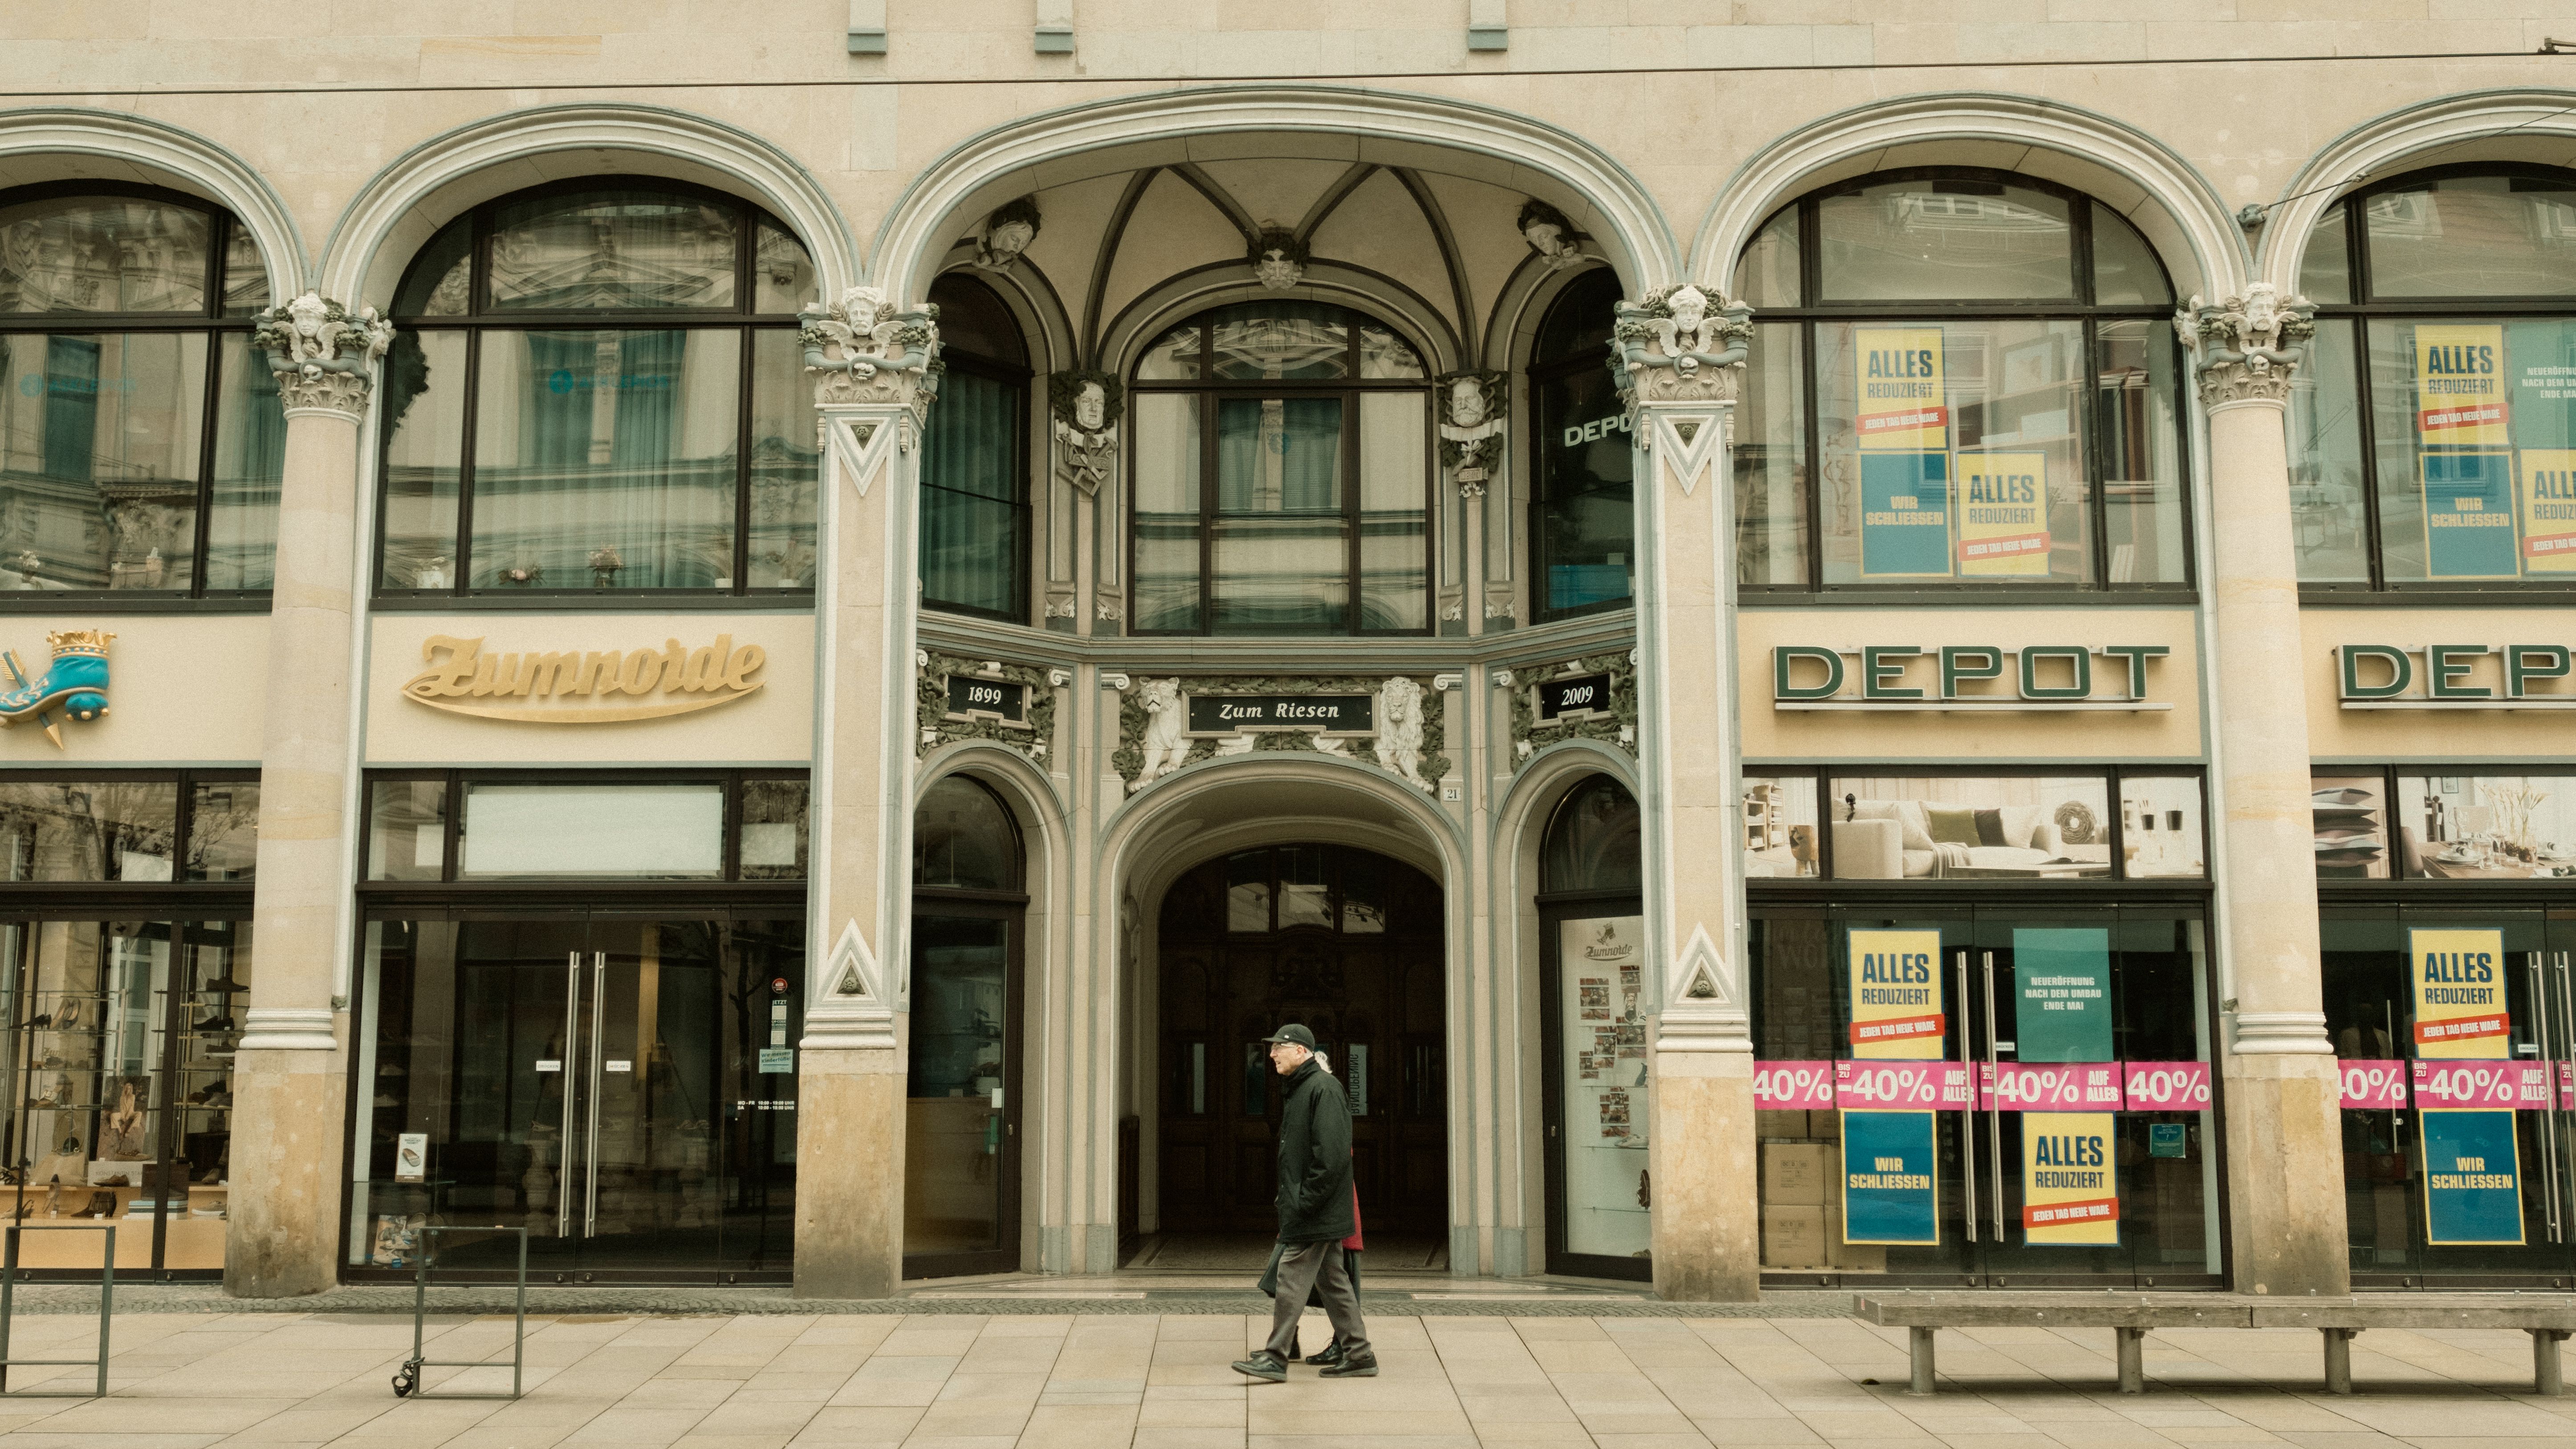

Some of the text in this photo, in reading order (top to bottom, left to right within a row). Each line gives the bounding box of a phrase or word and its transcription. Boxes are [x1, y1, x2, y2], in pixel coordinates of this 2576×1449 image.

[1868, 350, 1933, 377] ALLES
[2428, 345, 2493, 374] ALLES
[1868, 382, 1933, 398] REDUZIERT
[2429, 379, 2495, 394] REDUZIERT
[2522, 379, 2544, 387] NACH
[2547, 379, 2564, 387] DEM
[2540, 390, 2561, 398] ENDE
[1865, 418, 1885, 429] JEDEN
[1886, 417, 1900, 426] TAG
[1918, 412, 1939, 423] WARE
[2427, 409, 2500, 425] JEDEN TAG NEUE WARE
[1970, 475, 2035, 503] ALLES
[1891, 496, 1918, 509] WIR
[2455, 498, 2483, 511] WIR
[1866, 512, 1944, 525] SCHLIESSEN
[1970, 508, 2036, 524] REDUZIERT
[2431, 513, 2510, 527] SCHLIESSEN
[2554, 538, 2568, 549] TAG
[402, 633, 767, 700] Zumnorde
[1774, 645, 2170, 701] DEPOT
[2336, 644, 2572, 699] DEP
[968, 686, 1001, 704] 1899
[1561, 686, 1593, 706] 2009
[1219, 702, 1339, 719] Zum Riesen
[1447, 789, 1457, 799] 21
[1584, 944, 1632, 957] Zumnorde
[1862, 953, 1929, 983] ALLES
[2425, 953, 2492, 983] ALLES
[2031, 975, 2095, 986] NEUERÖFFNUNG
[1862, 988, 1930, 1005] REDUZIERT
[2025, 990, 2102, 998] NACH DEM UMBAU
[2425, 988, 2494, 1004] REDUZIERT
[2044, 1002, 2084, 1010] ENDE MAI
[1860, 1020, 1936, 1038] JEDEN TAG NEUE WARE
[2424, 1020, 2501, 1037] JEDEN TAG NEUE WARE
[1945, 1070, 1966, 1085] AUF
[2088, 1071, 2109, 1086] AUF
[2414, 1069, 2513, 1100] -40%
[2522, 1069, 2543, 1084] AUF
[1754, 1069, 1832, 1101] 40%
[1838, 1070, 1936, 1102] -40%
[2127, 1071, 2210, 1103] 40%
[2087, 1087, 2118, 1102] ALLES
[2036, 1136, 2103, 1166] ALLES
[1875, 1157, 1903, 1172] WIR
[2456, 1157, 2485, 1171] WIR
[1850, 1174, 1929, 1189] SCHLIESSEN
[2035, 1172, 2104, 1188] REDUZIERT
[2432, 1175, 2513, 1189] SCHLIESSEN
[2033, 1205, 2110, 1222] JEDEN TAG NEUE WARE
